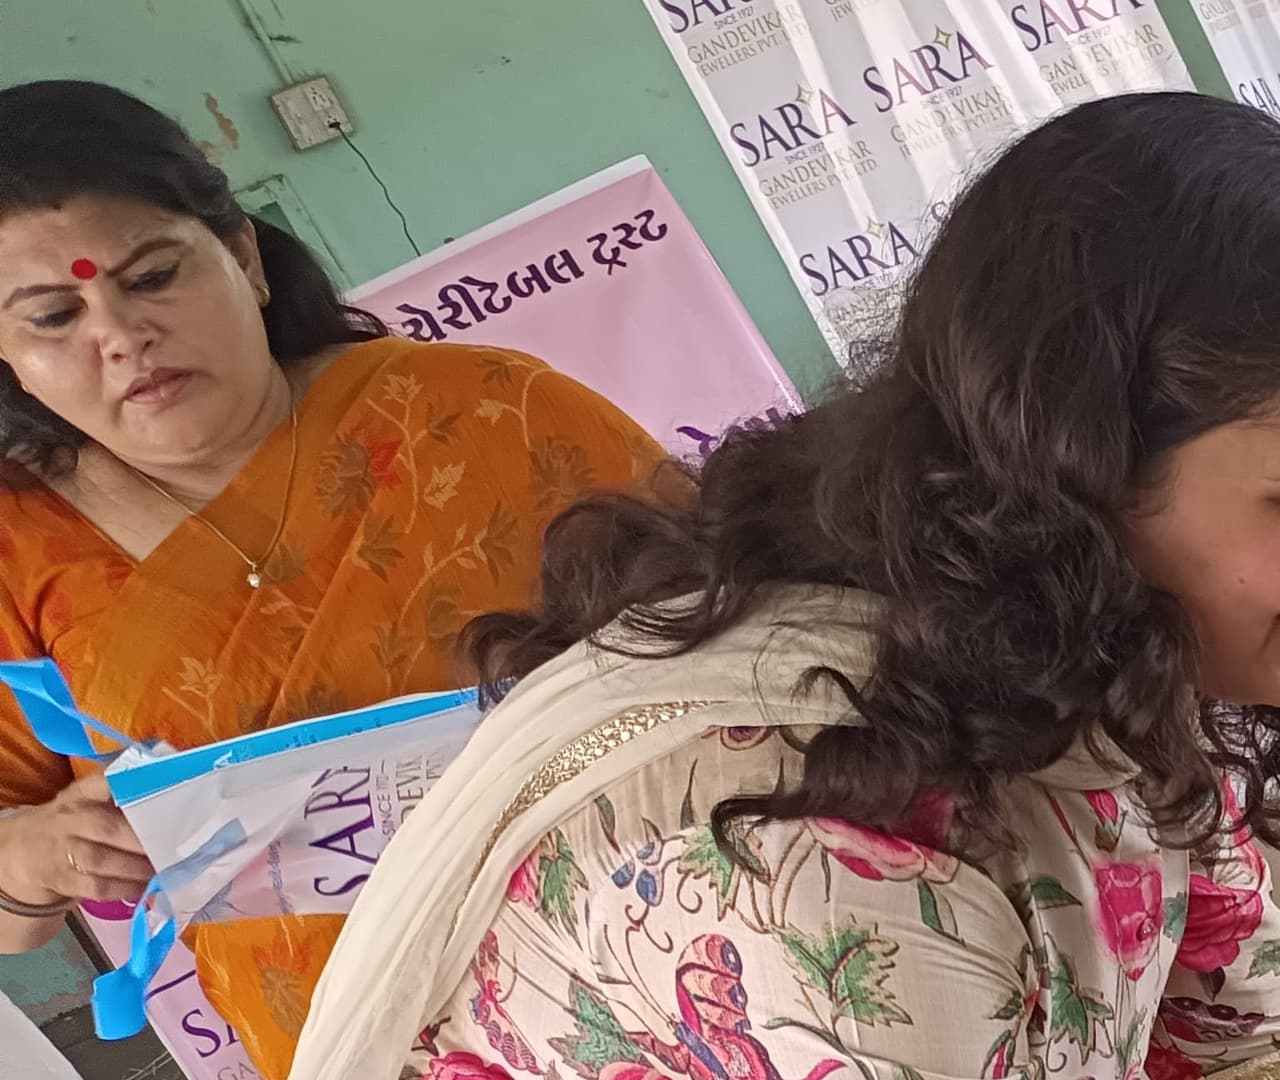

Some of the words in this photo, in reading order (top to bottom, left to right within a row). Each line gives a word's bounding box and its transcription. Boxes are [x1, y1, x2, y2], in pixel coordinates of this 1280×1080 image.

[697, 45, 757, 77] EWELLERS
[863, 31, 995, 113] SARA
[1040, 23, 1160, 83] GANEVIKAR
[730, 89, 858, 167] SARA
[759, 140, 873, 197] GANDEVIKAR
[768, 179, 826, 209] EWELLERS
[396, 249, 585, 342] ચેરીટેબલ
[587, 209, 668, 276] ટ્રસ્ટ
[800, 221, 922, 296] SARA
